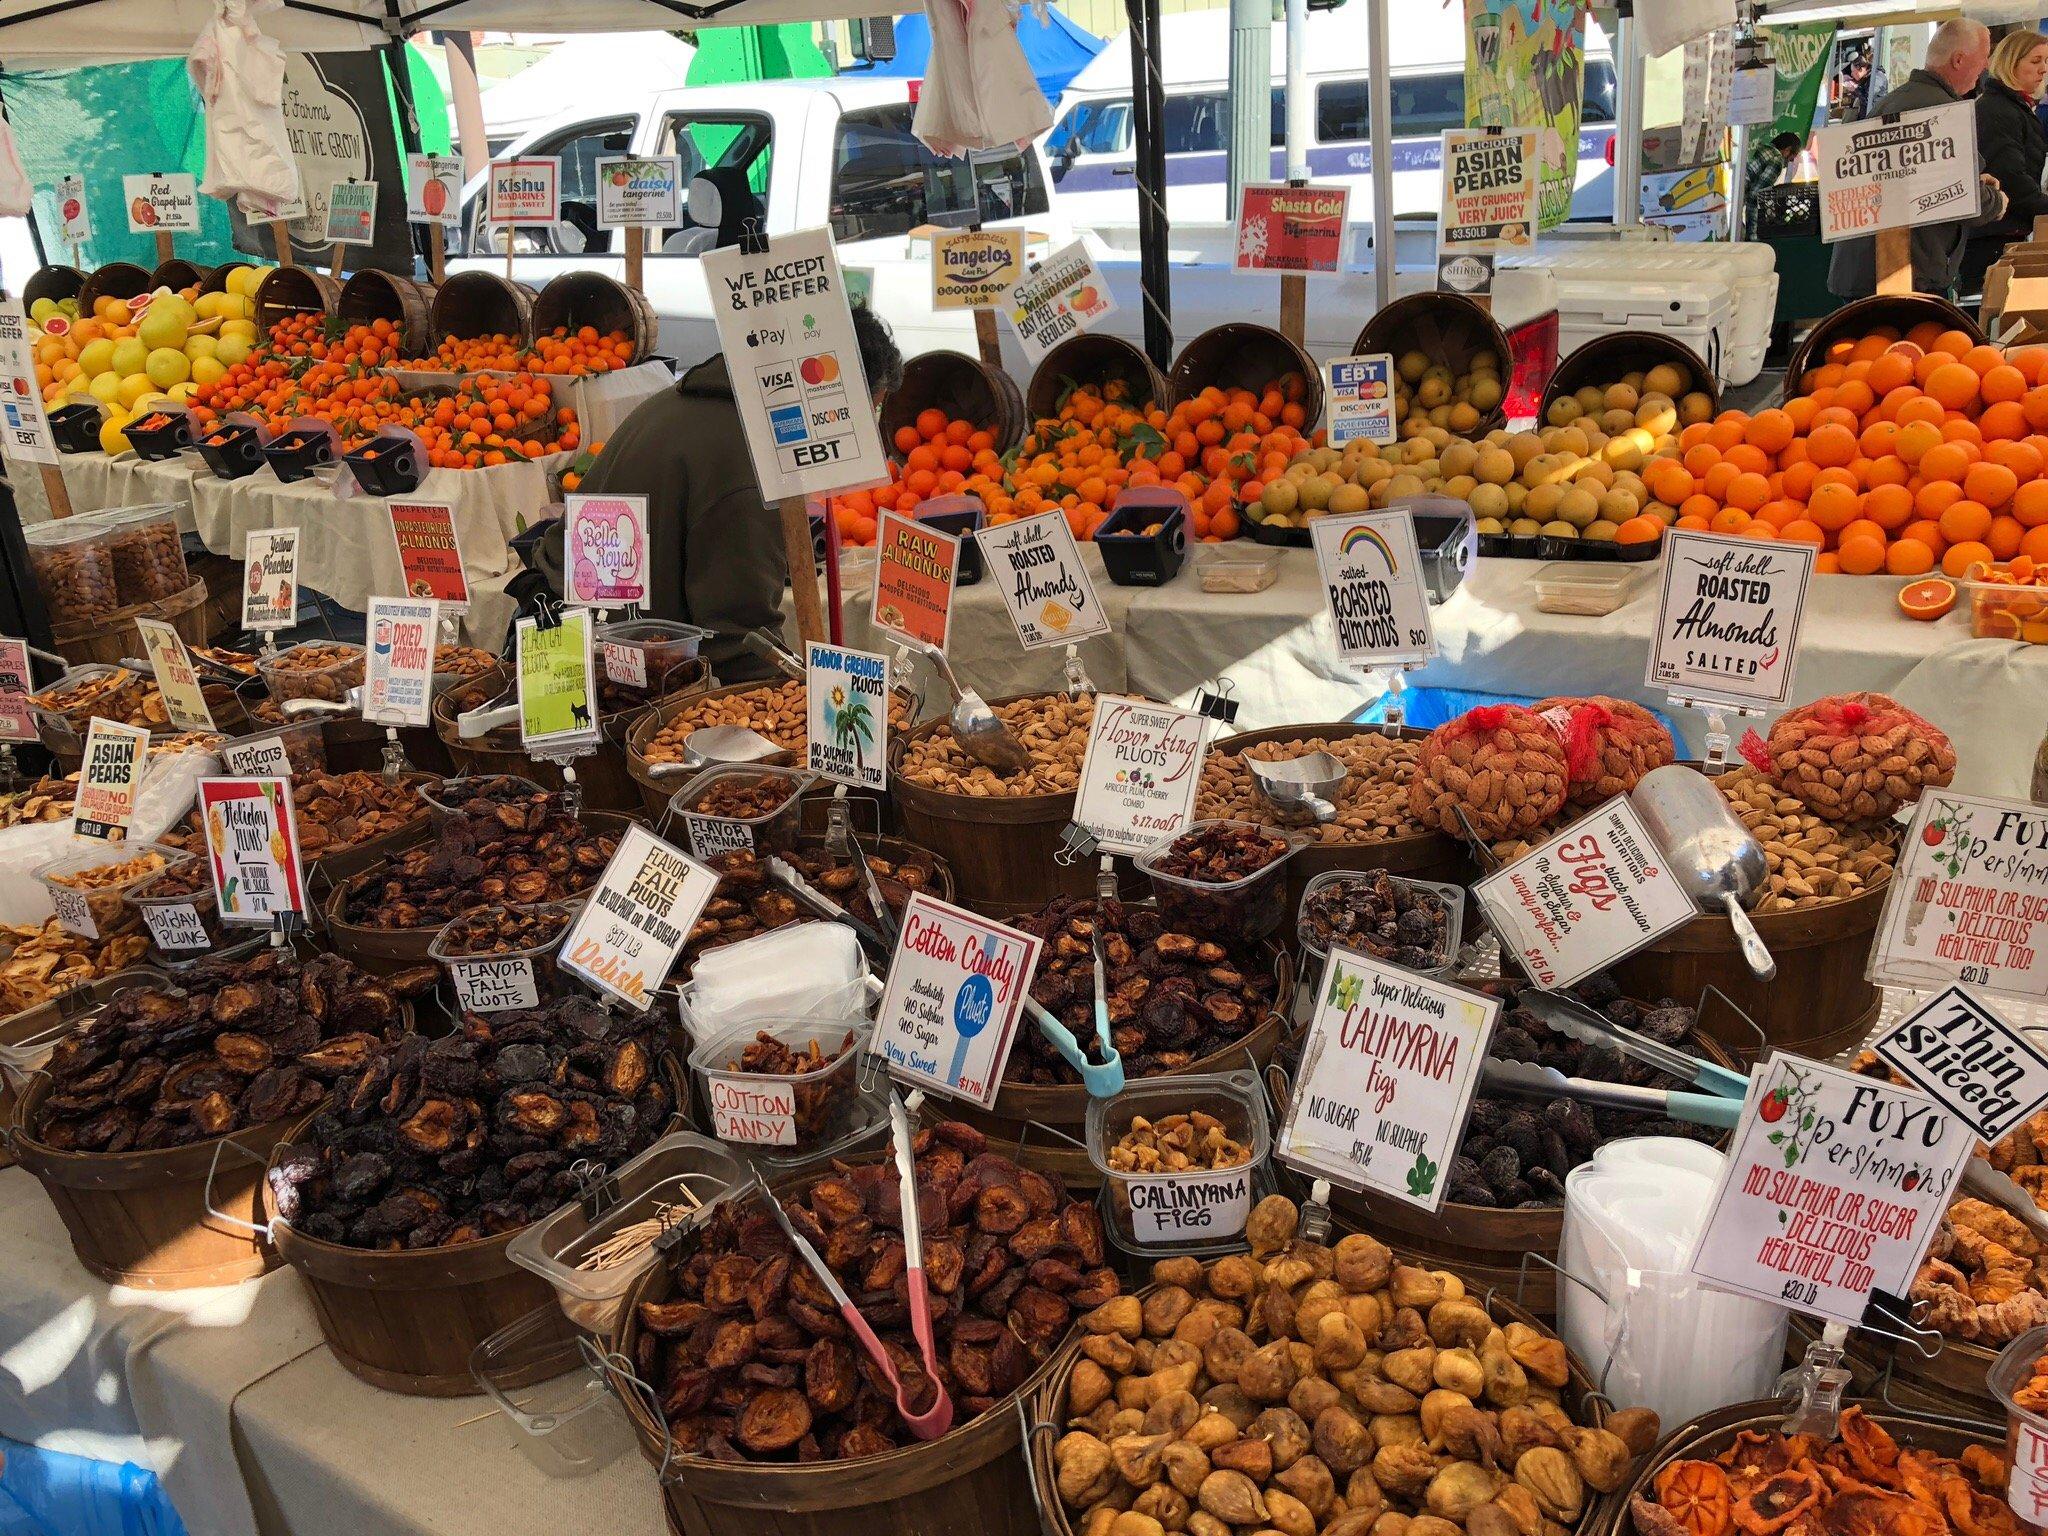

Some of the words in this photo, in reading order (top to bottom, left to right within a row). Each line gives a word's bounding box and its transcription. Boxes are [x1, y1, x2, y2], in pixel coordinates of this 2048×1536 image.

[288, 90, 331, 121] Farms
[307, 132, 327, 155] WE
[328, 133, 362, 159] GROW
[1456, 137, 1518, 152] DELICIOUS
[1856, 124, 1926, 148] amazing
[1456, 145, 1522, 176] ASIAN
[1836, 149, 1891, 180] cara
[1899, 136, 1956, 168] cara
[498, 178, 544, 192] Kishu
[629, 177, 674, 192] daisy
[1453, 166, 1522, 194] PEARS
[1872, 167, 1917, 182] oranges
[150, 184, 171, 195] Red
[622, 189, 665, 199] tangerine
[1456, 196, 1480, 209] VERY
[1483, 192, 1526, 206] CRUNCHY
[1828, 182, 1882, 202] SEEDLESS
[1918, 184, 1964, 210] $2.25LB
[151, 195, 192, 211] Grapefruit
[1271, 197, 1311, 213] Shasta
[1314, 199, 1342, 215] Gold
[1458, 208, 1487, 224] VERY
[1491, 204, 1524, 221] JUICY
[1830, 205, 1882, 232] JUICY
[1452, 227, 1487, 239] $3.50LB
[942, 245, 1011, 267] Tangelos
[725, 271, 757, 291] WE
[764, 256, 826, 283] ACCEPT
[1014, 258, 1085, 307] Satsuma
[1447, 266, 1483, 275] SHINKO
[731, 294, 748, 311] &
[752, 276, 830, 308] PREFER
[1018, 315, 1038, 339] EASY
[1035, 303, 1057, 326] PEEL
[1037, 312, 1077, 348] SEEDLESS
[761, 328, 785, 346] Pay
[804, 328, 821, 340] pay
[760, 371, 793, 388] VISA
[1341, 365, 1377, 382] EBT
[807, 381, 842, 393] mastercard
[1336, 388, 1355, 396] VISA
[812, 407, 850, 426] DISCOVER
[1340, 403, 1380, 412] DISCOVER
[1334, 419, 1386, 429] AMERICAN
[1345, 428, 1389, 437] EXPRESS
[17, 432, 36, 445] EBT
[793, 440, 841, 467] EBT
[395, 521, 453, 534] UNPASTEURIZED
[584, 525, 620, 547] Bella
[270, 536, 295, 558] Yellow
[400, 534, 456, 550] ALMONDS
[898, 530, 938, 559] RAW
[263, 554, 294, 577] Peaches
[596, 546, 636, 576] Royal
[884, 544, 950, 583] ALMONDS
[1008, 545, 1056, 571] ROASTED
[1706, 551, 1735, 575] soft
[1735, 553, 1772, 576] shell
[897, 579, 931, 599] DELICIOUS
[1014, 562, 1077, 610] Almonds
[1697, 574, 1771, 605] ROASTED
[1329, 580, 1392, 619] ROASTED
[1673, 598, 1778, 647] Almonds
[393, 623, 422, 647] DRIED
[1409, 629, 1426, 646] $10
[391, 647, 427, 671] APRICOTS
[605, 643, 638, 666] BELLA
[811, 649, 842, 671] FLAVOR
[845, 655, 884, 679] GRENADE
[1668, 662, 1675, 670] LB
[1686, 651, 1758, 675] SALTED
[608, 662, 641, 683] ROYAL
[851, 675, 884, 696] PLUOTS
[1130, 712, 1149, 726] SUPER
[1150, 717, 1170, 730] SWEET
[92, 744, 134, 763] ASIAN
[811, 742, 821, 757] NO
[824, 745, 853, 764] SULPHUR
[1115, 744, 1167, 766] PLUOTS
[88, 765, 131, 784] PEARS
[811, 758, 823, 769] NO
[825, 761, 855, 777] SUGAR
[109, 791, 127, 804] NO
[1122, 798, 1145, 809] COMBO
[1145, 788, 1170, 800] CHERRY
[90, 811, 119, 823] ADDED
[113, 804, 133, 815] SUGAR
[220, 800, 269, 842] Holiday
[81, 822, 92, 833] $17
[93, 824, 101, 835] LB
[690, 819, 745, 837] FLAVOR
[693, 829, 753, 849] GRENADE
[1609, 813, 1627, 837] SIMPLY
[1622, 834, 1649, 870] DELICIOUS
[1643, 866, 1658, 878] &
[646, 844, 690, 883] FLAVOR
[1607, 831, 1646, 885] NUTRITIOUS
[636, 863, 679, 898] FALL
[1557, 834, 1617, 912] Figs
[627, 882, 671, 918] PLUOTS
[1604, 866, 1628, 895] black
[1622, 895, 1651, 933] mission
[596, 886, 608, 905] NO
[606, 891, 636, 922] SULPHUR
[642, 912, 656, 933] NO
[650, 920, 681, 950] SUGAR
[159, 930, 207, 946] PLUMS
[605, 925, 624, 948] $17
[624, 937, 643, 958] LB
[459, 961, 528, 979] FLAVOR
[904, 914, 957, 963] Cotton
[961, 935, 1014, 1003] Candy
[1525, 948, 1548, 971] $15
[1539, 971, 1556, 986] lb
[470, 977, 516, 995] FALL
[909, 978, 945, 1006] Absolutely
[1371, 974, 1402, 1007] Super
[1402, 986, 1446, 1019] Delicious
[460, 991, 524, 1007] PLUOTS
[959, 983, 989, 1025] Pluots
[1340, 1002, 1459, 1084] CALIMYRNA
[1934, 1004, 2026, 1098] Thin
[884, 1040, 905, 1066] Very
[908, 1051, 937, 1076] Sweet
[1366, 1059, 1397, 1114] Figs
[1895, 1024, 2021, 1133] Sliced
[715, 1083, 790, 1116] COTTON
[1308, 1095, 1323, 1119] NO
[1324, 1104, 1360, 1132] SUGAR
[1842, 1086, 1948, 1148] FUYU
[715, 1111, 786, 1144] CANDY
[1375, 1119, 1389, 1142] NO
[1388, 1128, 1428, 1155] SULPHUR
[1743, 1163, 1769, 1196] NO
[1767, 1170, 1841, 1220] SULPHUR
[1839, 1192, 1865, 1225] OR
[1862, 1199, 1918, 1241] SUGAR
[1786, 1212, 1876, 1261] DELICIOUS
[1757, 1237, 1836, 1287] HEALTHFUL,
[1838, 1259, 1876, 1294] TOO!
[1782, 1280, 1803, 1300] $20
[1802, 1284, 1818, 1305] lb
